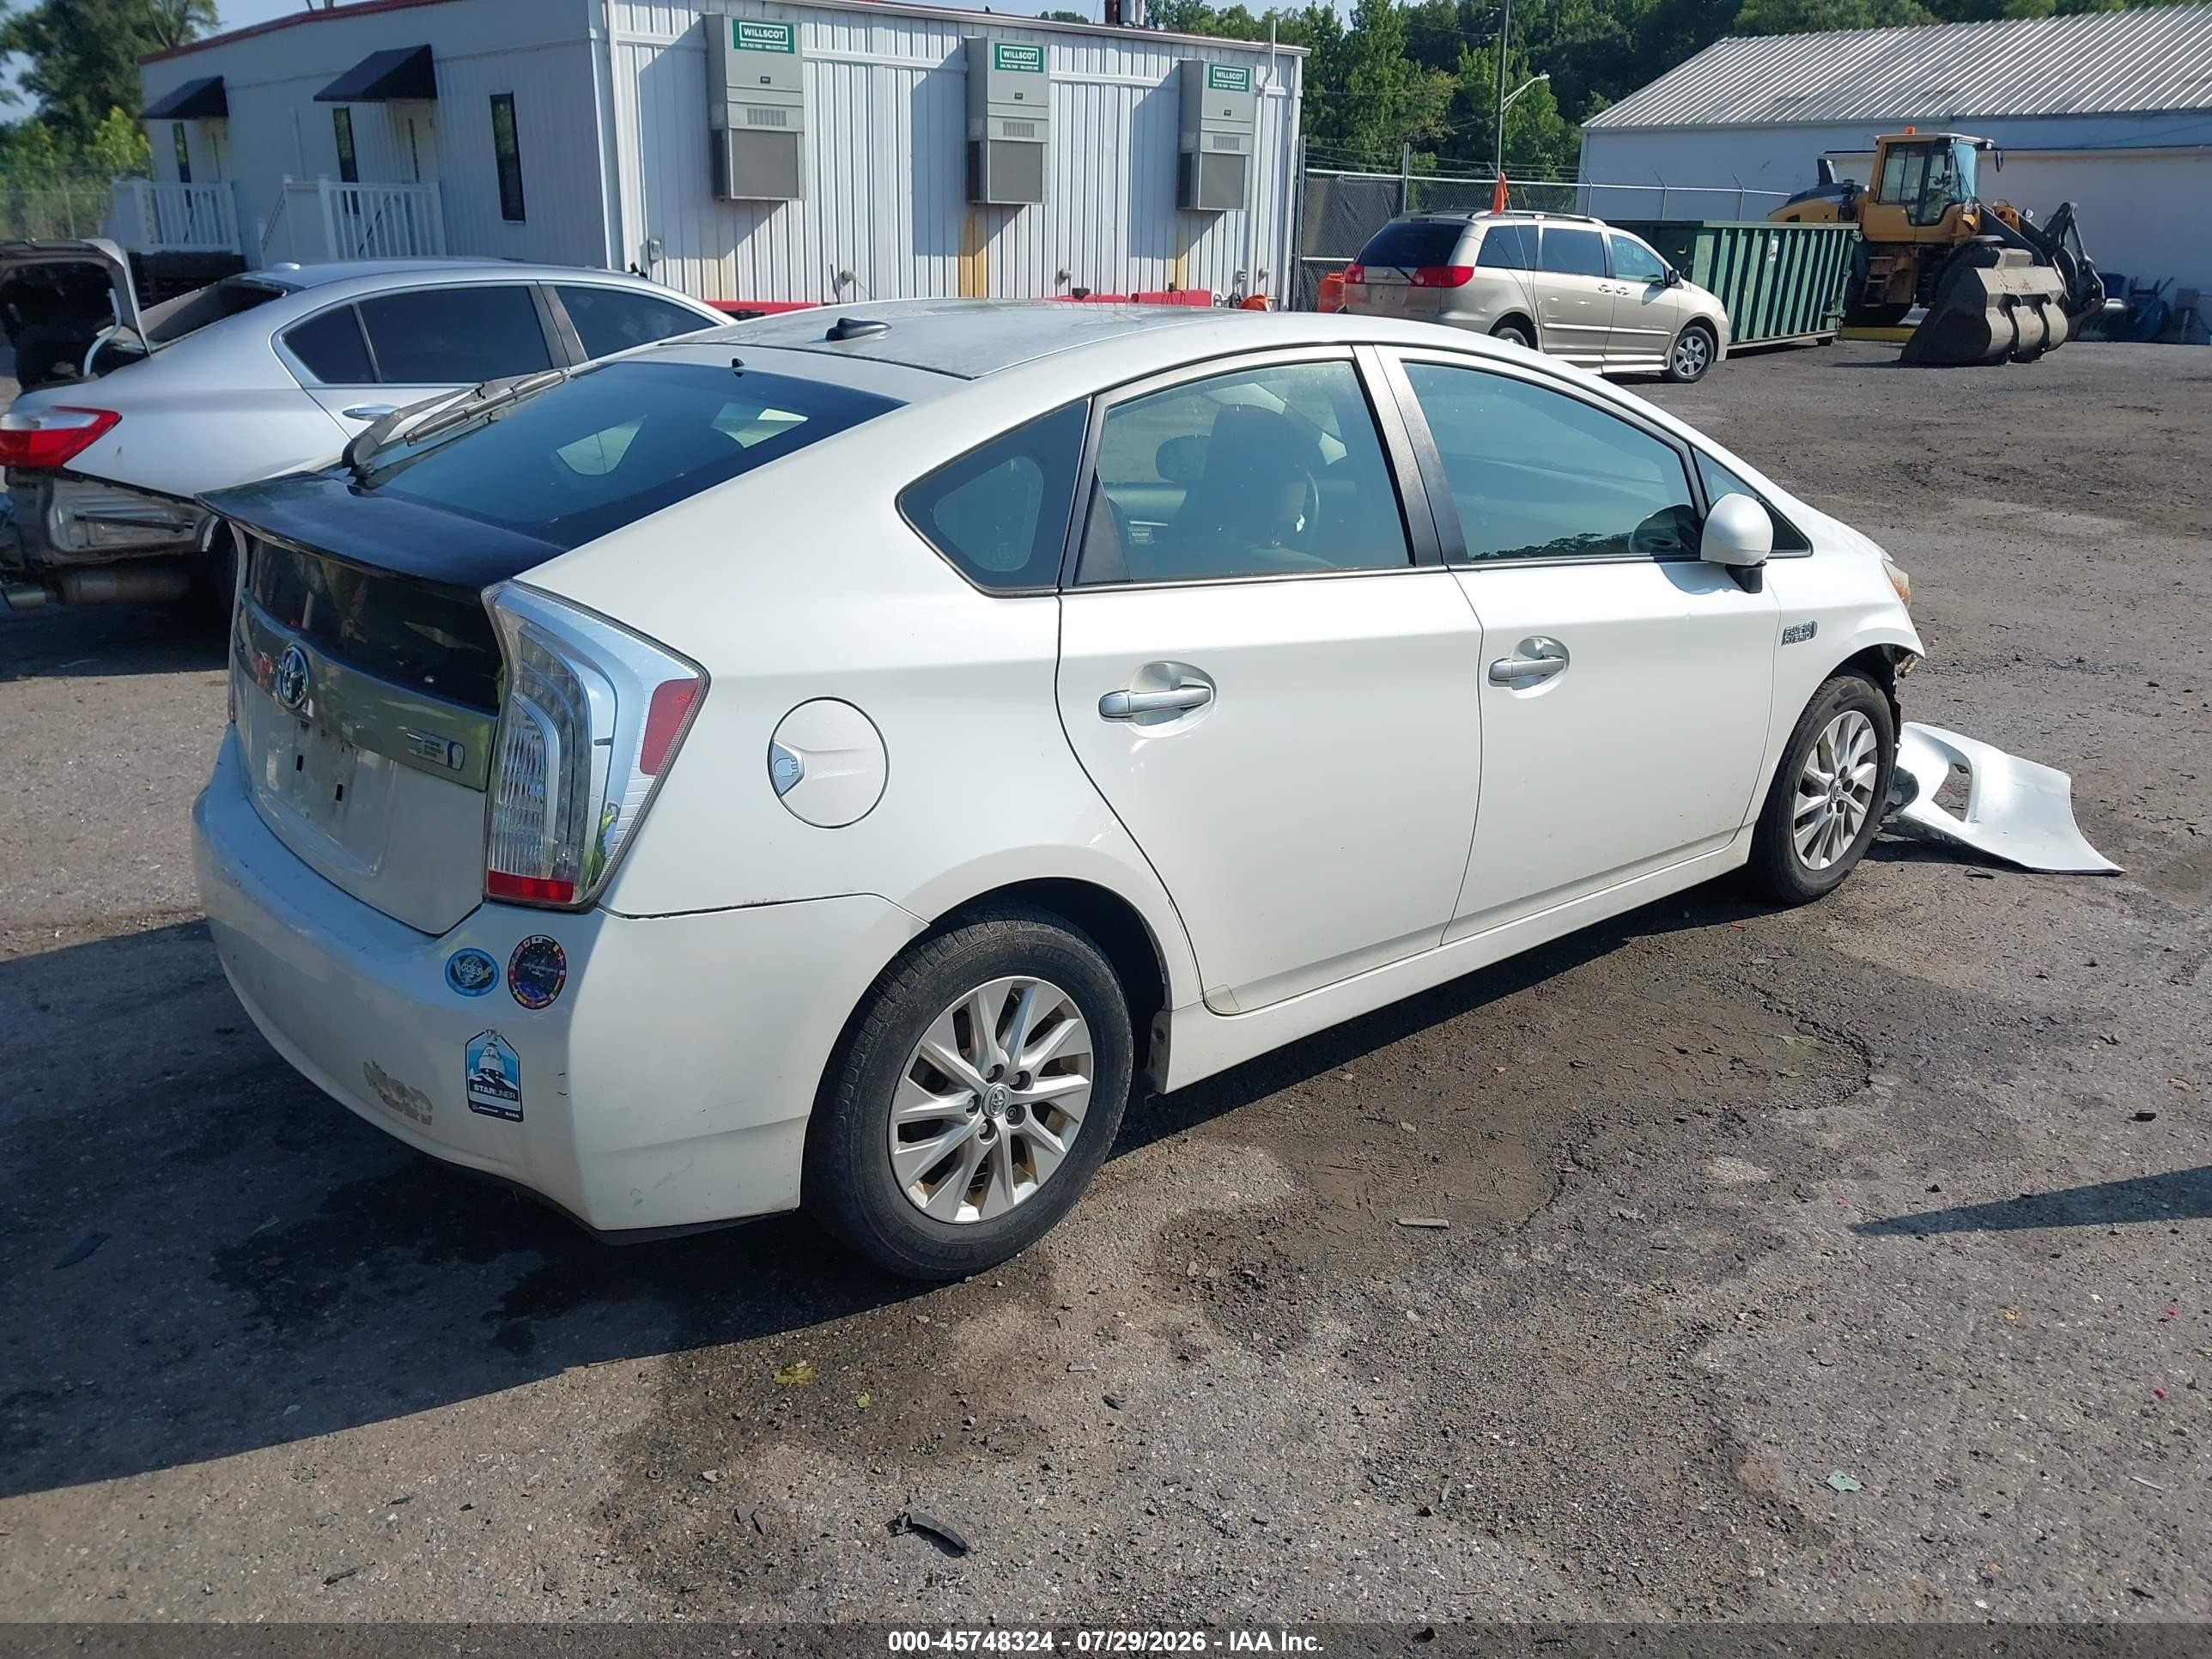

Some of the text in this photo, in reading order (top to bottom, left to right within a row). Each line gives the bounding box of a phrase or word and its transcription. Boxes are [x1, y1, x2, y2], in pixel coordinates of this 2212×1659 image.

[744, 27, 784, 39] WILLSCOT
[1003, 50, 1036, 60] WILLSCOT
[1216, 70, 1243, 81] WILLSCOT
[460, 963, 482, 976] GOES
[473, 1084, 515, 1099] STARLINER
